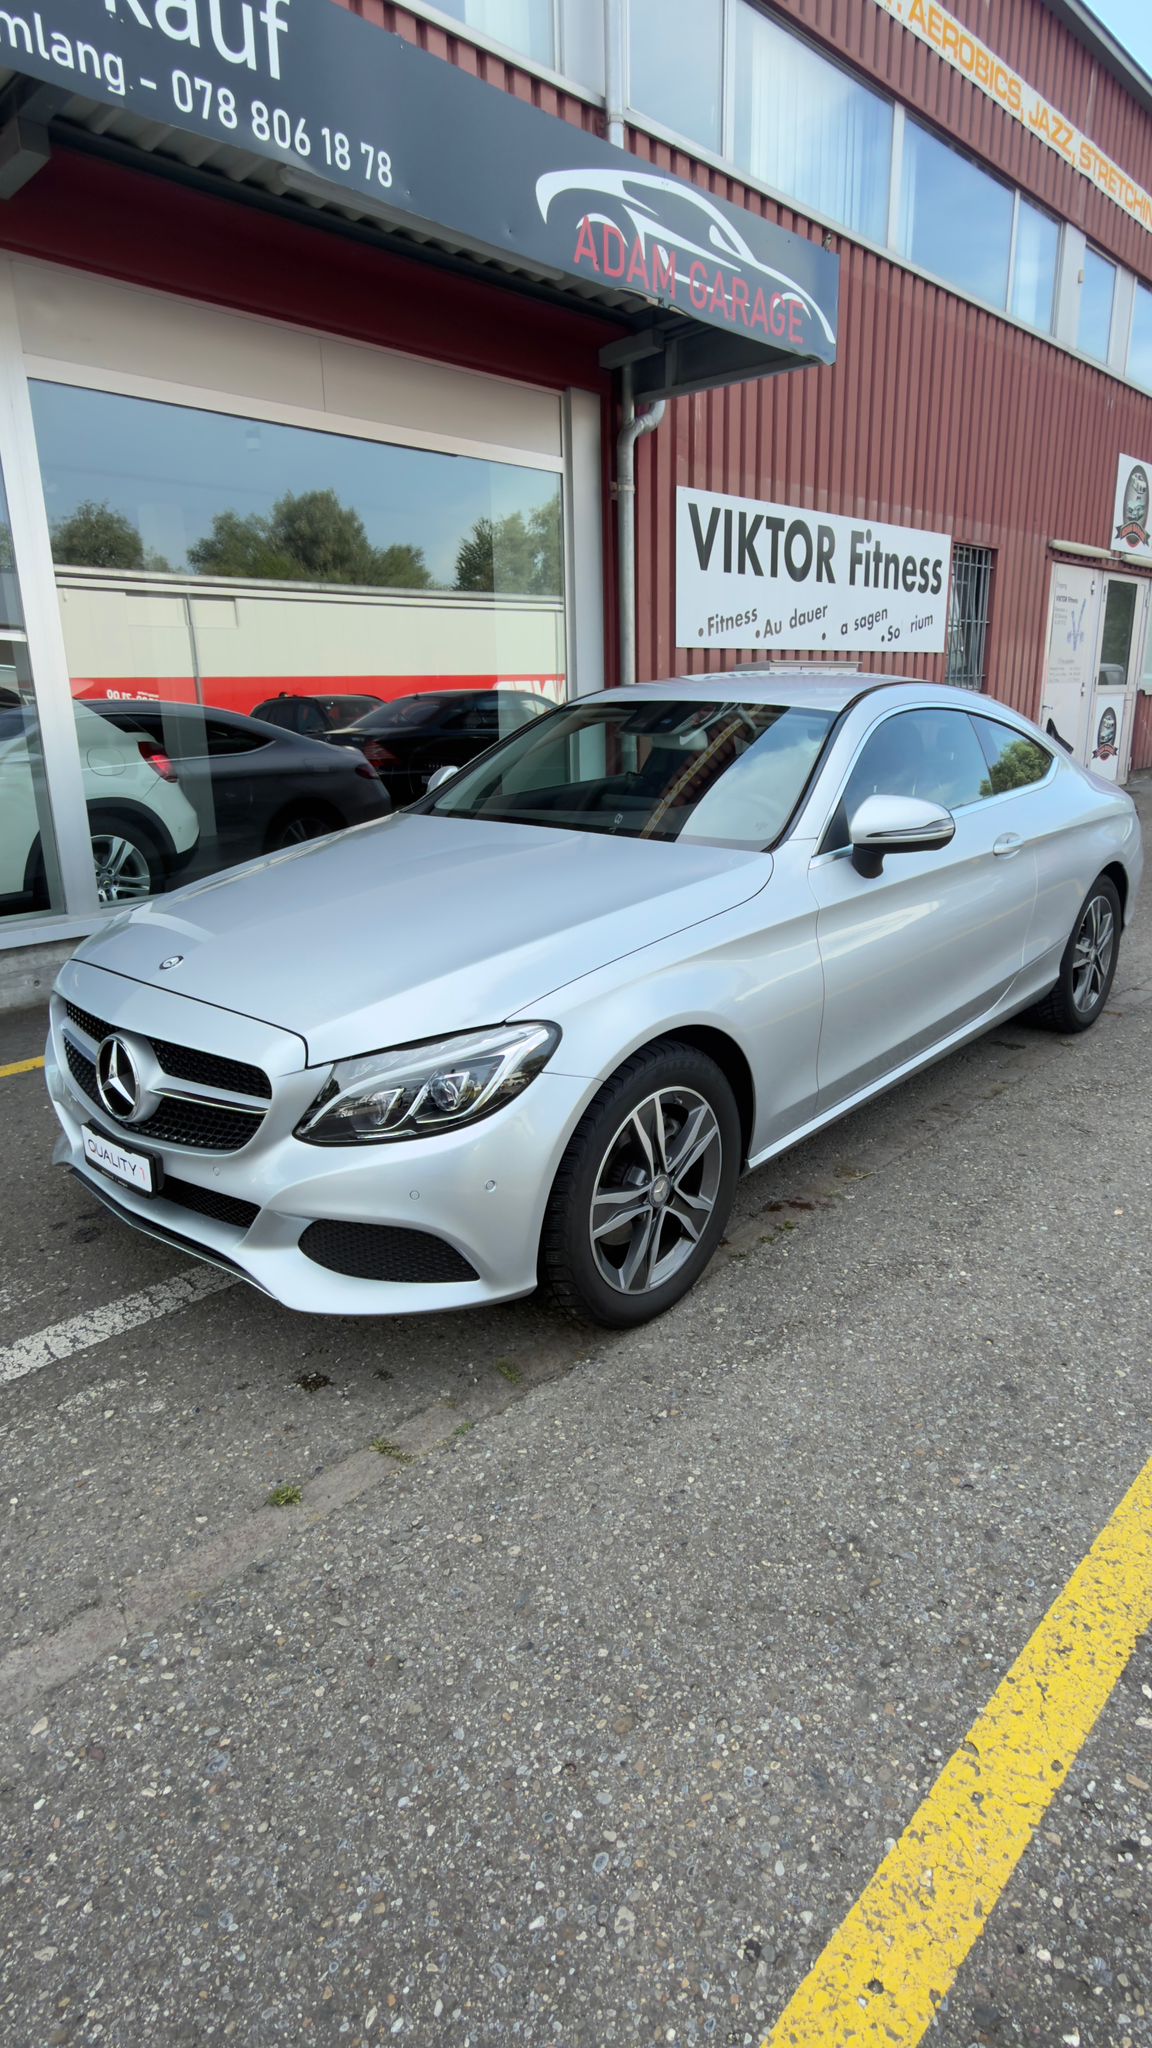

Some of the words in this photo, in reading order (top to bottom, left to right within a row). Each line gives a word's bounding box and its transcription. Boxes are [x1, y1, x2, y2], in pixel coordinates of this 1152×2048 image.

[105, 0, 290, 80] auf
[172, 69, 238, 129] 078
[252, 100, 312, 157] 806
[321, 127, 351, 172] 18
[360, 142, 393, 188] 78
[573, 214, 677, 300] ADAM
[689, 260, 805, 344] GARAGE
[688, 502, 836, 584] VIKTOR
[849, 528, 944, 596] Fitness
[87, 1138, 137, 1176] QUALITY
